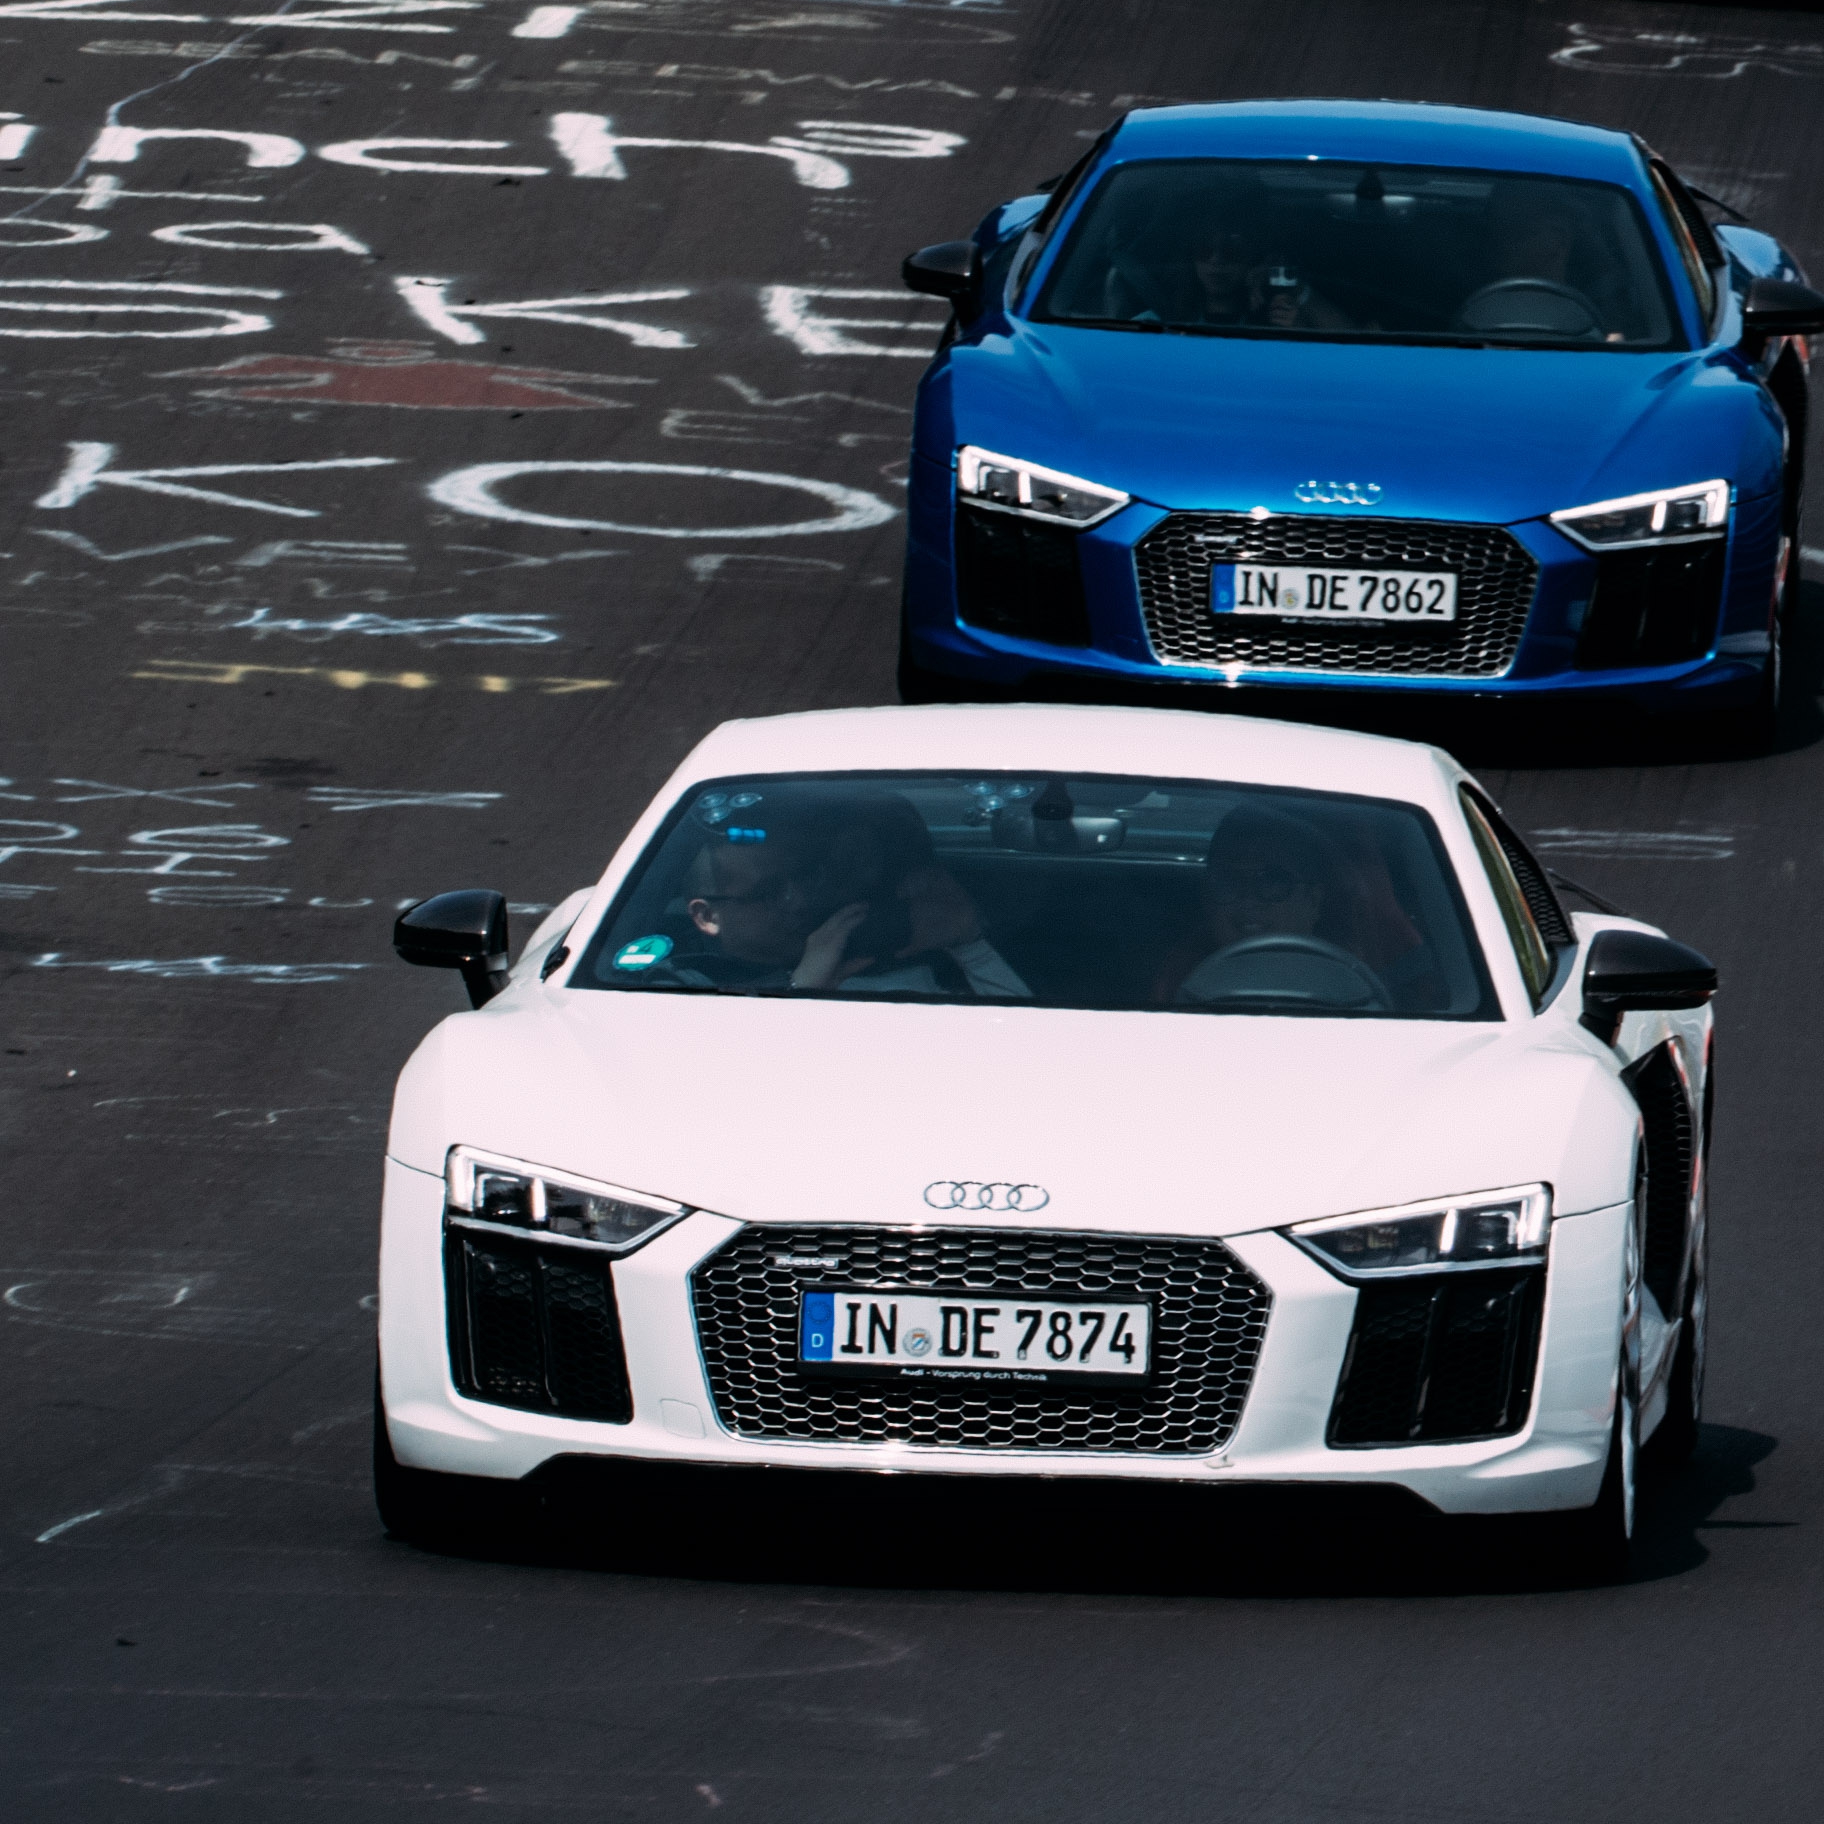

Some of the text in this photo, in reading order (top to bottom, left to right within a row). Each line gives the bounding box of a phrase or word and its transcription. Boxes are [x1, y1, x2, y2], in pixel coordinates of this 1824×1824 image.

[1239, 570, 1447, 615] IN DE 7862
[811, 1334, 824, 1349] D
[840, 1301, 1137, 1365] IN DE 7874
[900, 1368, 924, 1376] Audi
[932, 1369, 982, 1381] Vorsprung
[983, 1371, 1011, 1380] durch
[1012, 1371, 1048, 1381] Technik
